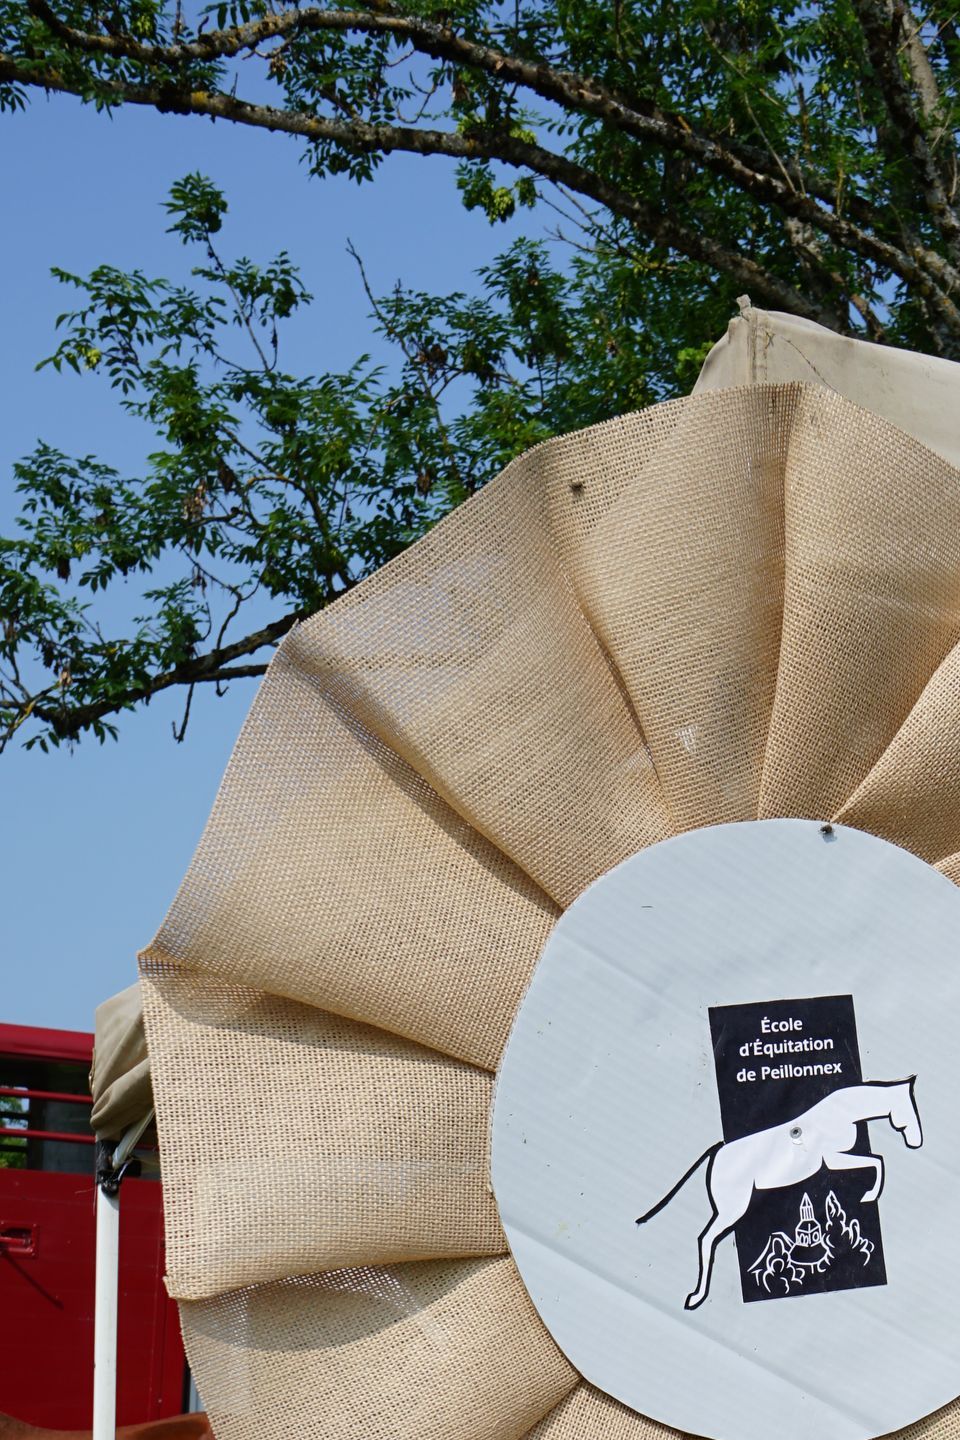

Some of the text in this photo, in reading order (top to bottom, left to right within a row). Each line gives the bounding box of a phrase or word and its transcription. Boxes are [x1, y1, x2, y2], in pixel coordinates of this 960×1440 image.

[761, 1016, 803, 1034] École
[739, 1037, 834, 1059] d'Équitation
[737, 1062, 843, 1083] de Peillonnex
